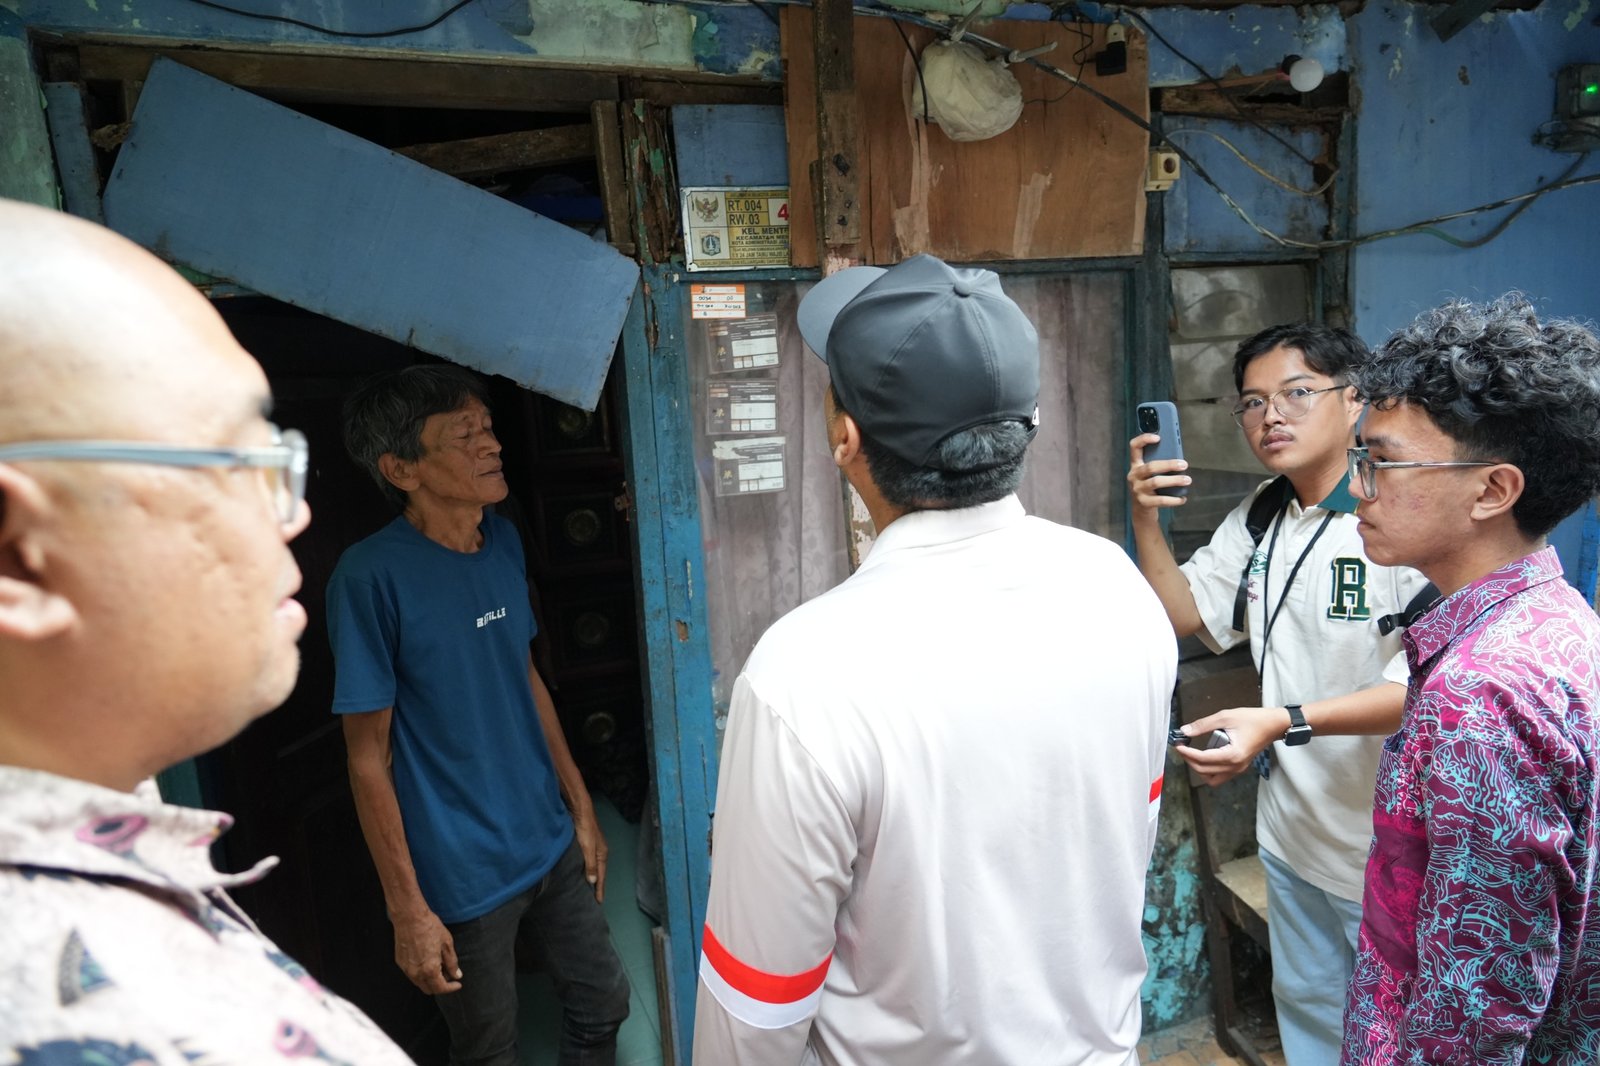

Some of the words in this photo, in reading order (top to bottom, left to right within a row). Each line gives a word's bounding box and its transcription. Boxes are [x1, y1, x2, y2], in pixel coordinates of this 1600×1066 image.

[728, 200, 743, 211] RT.
[744, 199, 762, 211] 004
[777, 203, 789, 221] 4
[729, 213, 748, 225] RW.
[749, 213, 760, 225] 03
[1327, 557, 1371, 621] R
